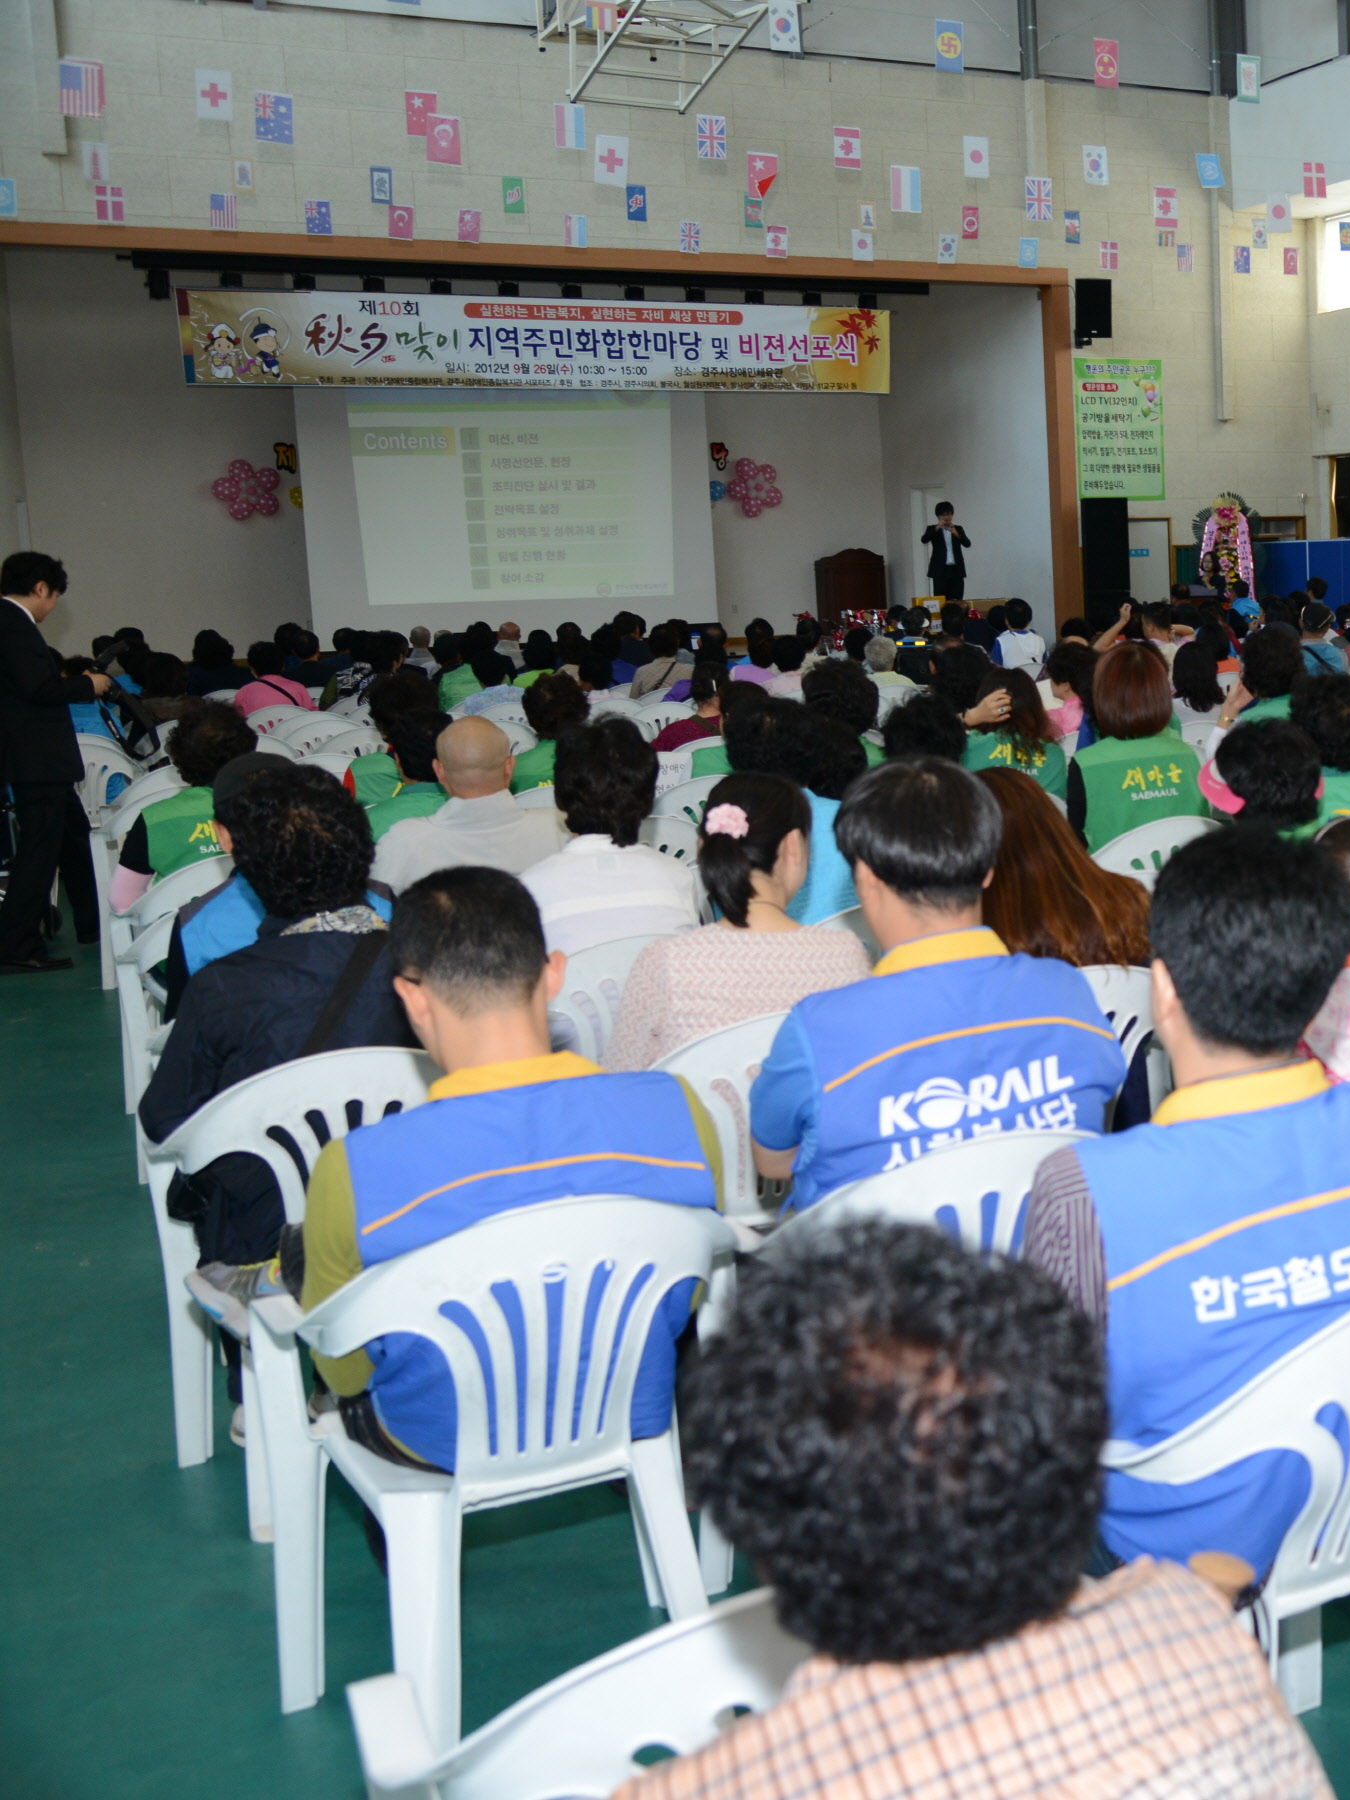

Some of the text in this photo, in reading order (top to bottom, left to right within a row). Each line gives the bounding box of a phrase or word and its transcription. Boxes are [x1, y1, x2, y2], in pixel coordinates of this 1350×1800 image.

[358, 300, 419, 316] 제10회
[480, 304, 730, 323] 실천하는 나눔복지, 실현하는 자비 세상 만들기
[468, 326, 702, 361] 지역주민화합한마당
[711, 337, 729, 360] 및
[738, 333, 857, 364] 비젼선포식
[445, 362, 470, 374] 일시:
[474, 363, 510, 375] 2012년
[513, 363, 530, 375] 9월
[534, 363, 574, 375] 26일(수)
[578, 365, 605, 375] 10:30
[621, 366, 647, 376] 15:00
[674, 366, 696, 378] 장소:
[701, 366, 783, 379] 경주시장애인체육관
[524, 379, 551, 387] 서포터즈
[559, 379, 572, 387] 후원
[580, 379, 593, 388] 협조
[1080, 396, 1138, 406] LCD TV(32인치)
[1081, 412, 1133, 424] 공기방울세탁기
[364, 432, 449, 450] Contents
[488, 433, 514, 446] 미션,
[517, 433, 539, 445] 비젼
[273, 442, 297, 474] 제
[1121, 762, 1183, 791] 새마을
[1131, 788, 1179, 801] SAEMAUL
[878, 1054, 1075, 1138] KORAIL
